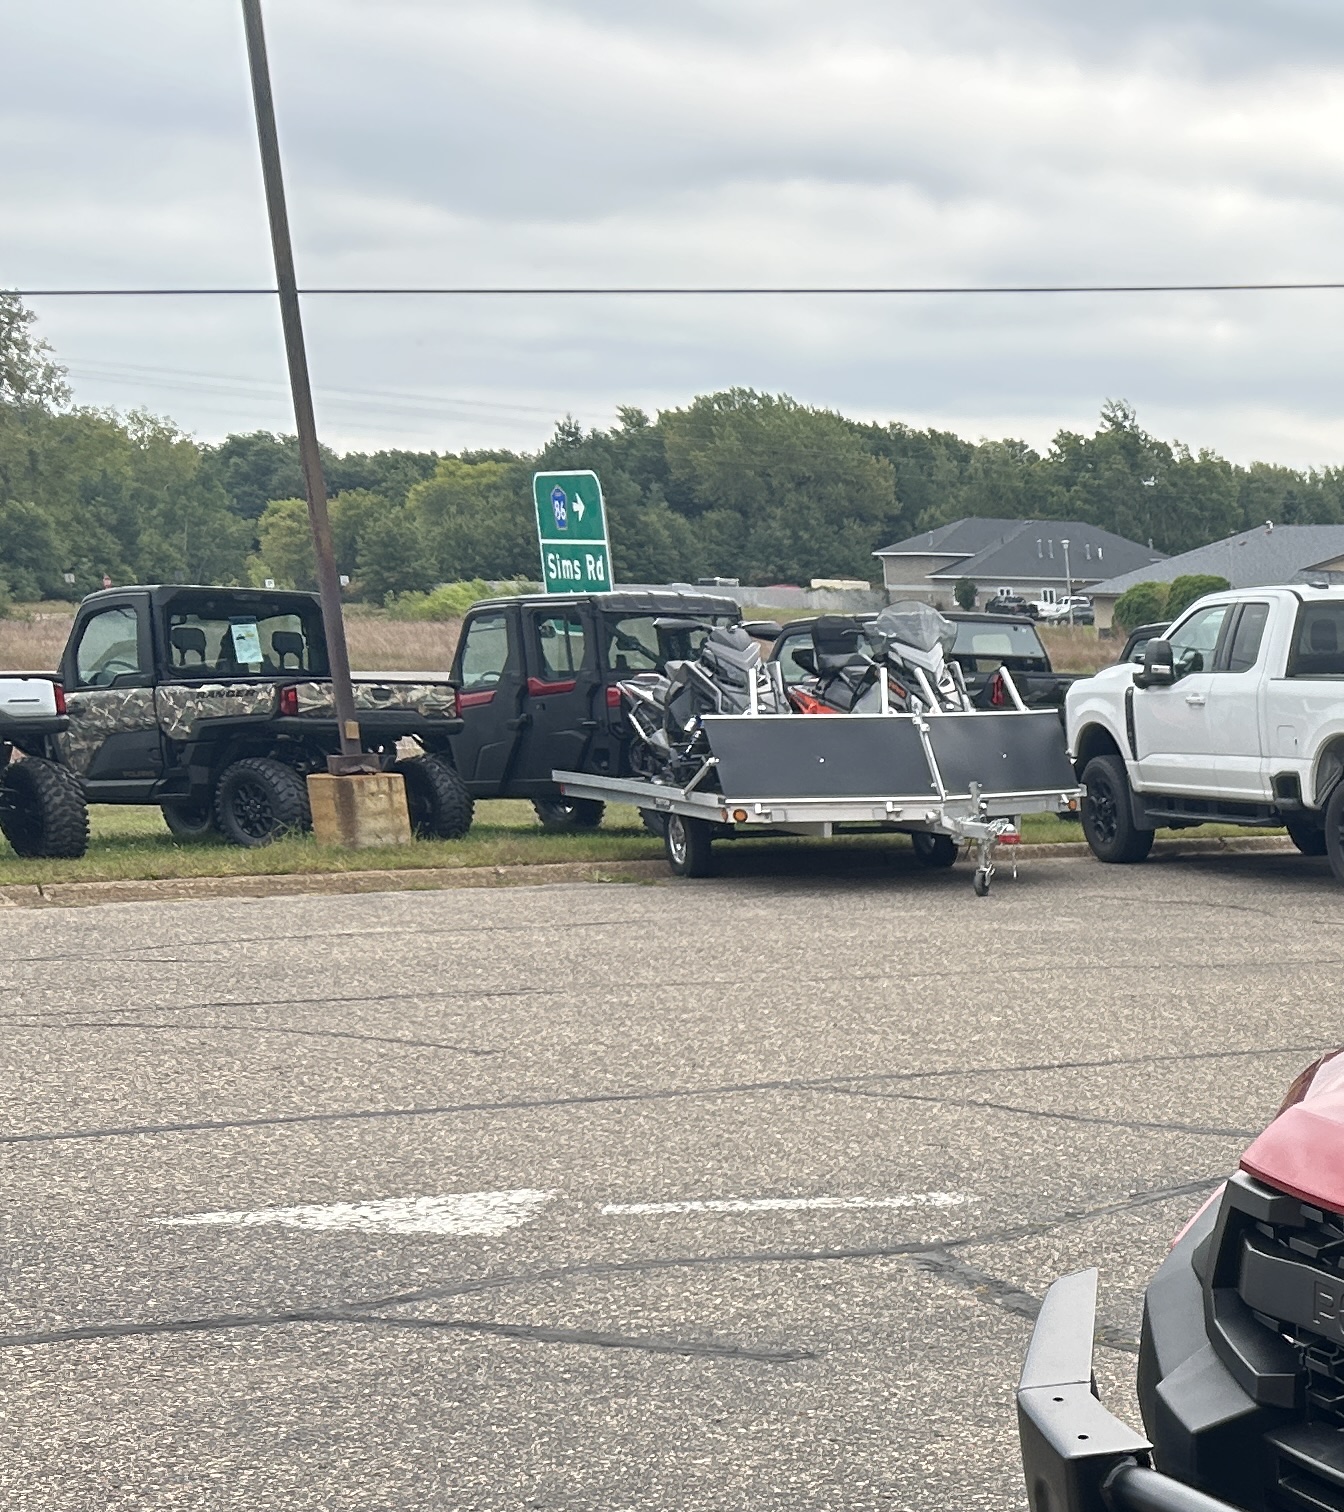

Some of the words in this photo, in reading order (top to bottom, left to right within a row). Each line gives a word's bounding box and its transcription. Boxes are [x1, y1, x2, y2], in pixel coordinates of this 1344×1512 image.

[554, 500, 567, 520] 86
[547, 553, 581, 581] Sims
[585, 554, 605, 581] Rd
[196, 689, 257, 699] RANGER
